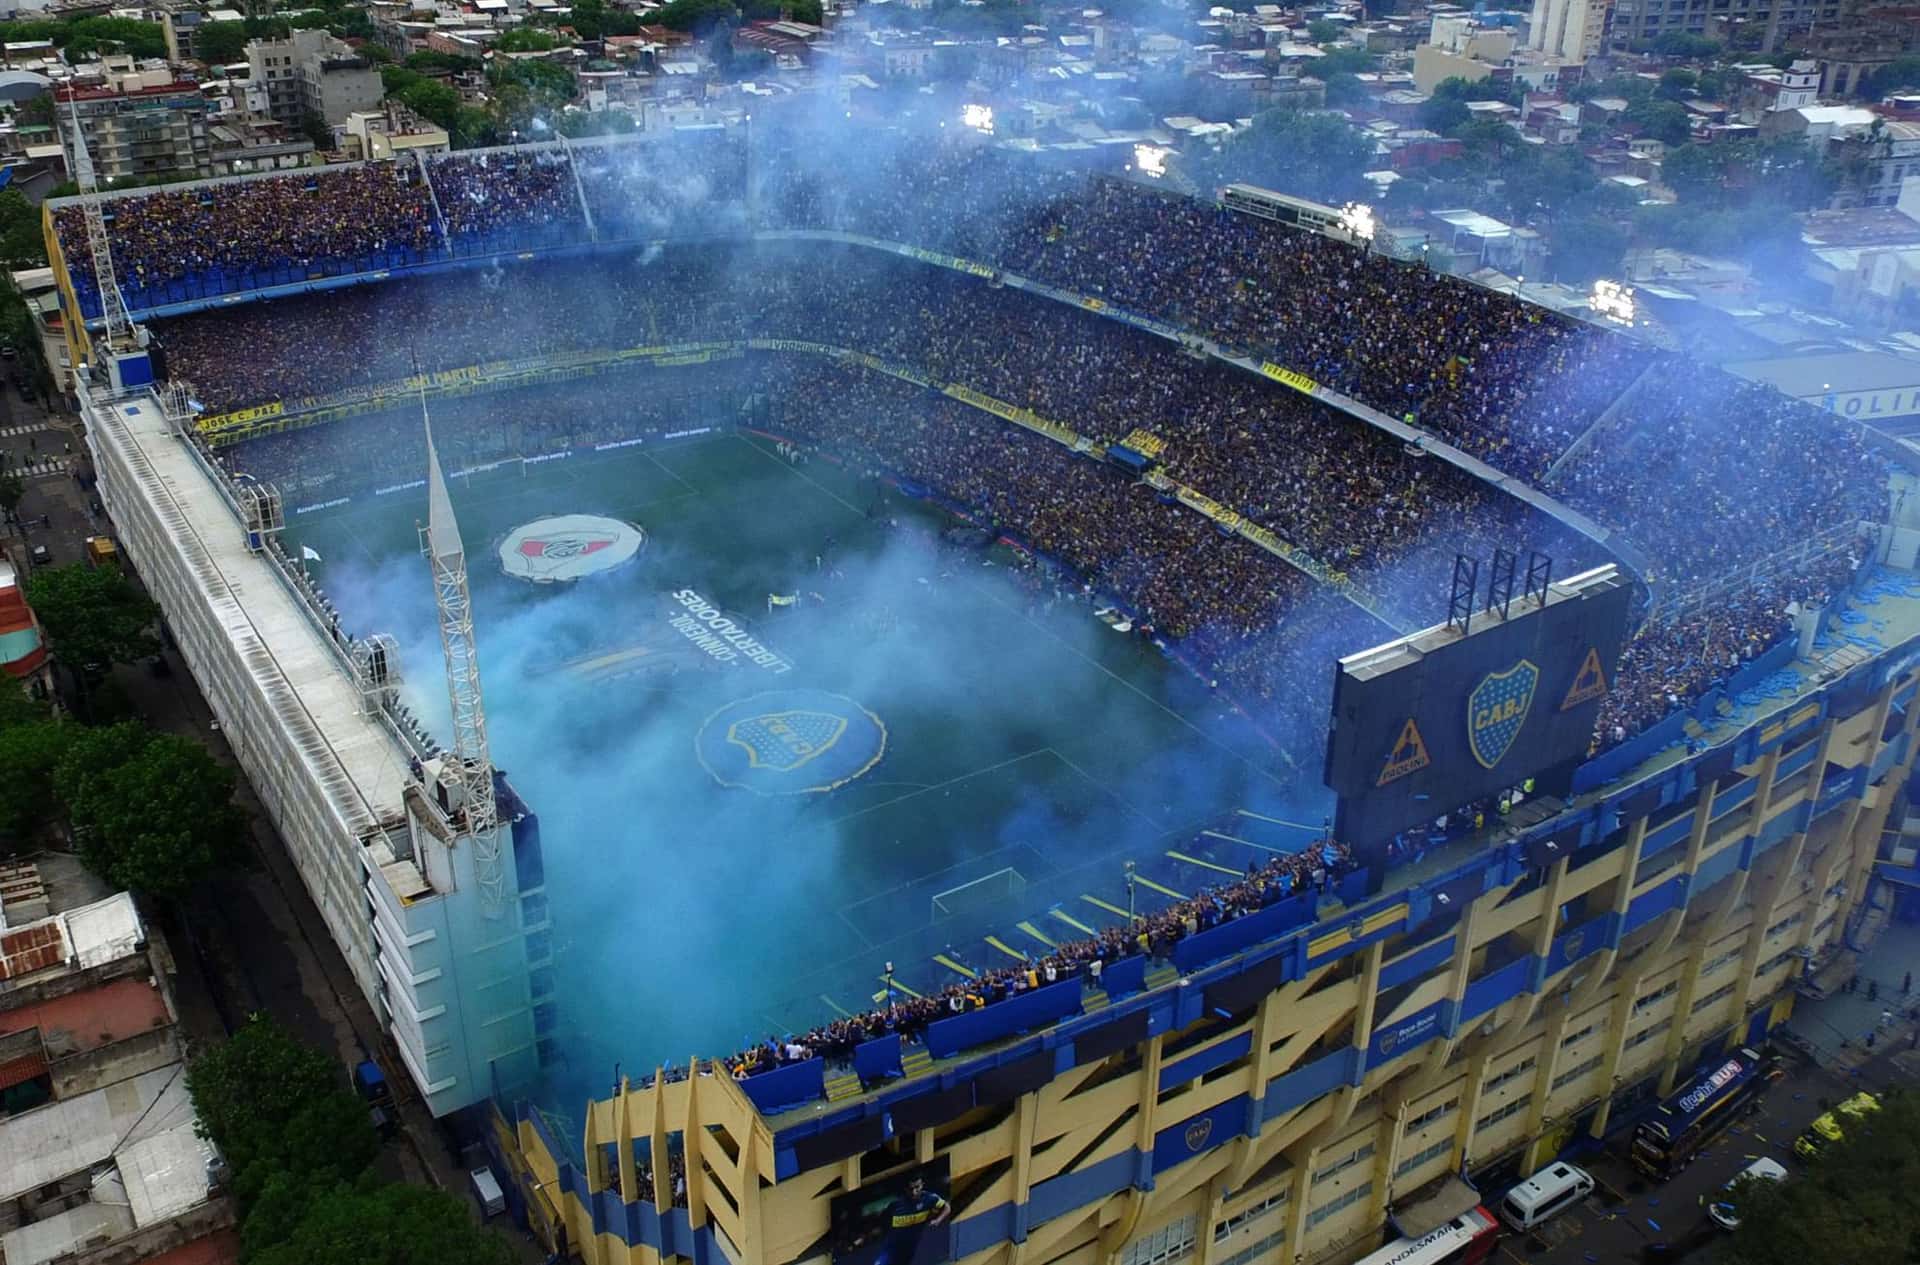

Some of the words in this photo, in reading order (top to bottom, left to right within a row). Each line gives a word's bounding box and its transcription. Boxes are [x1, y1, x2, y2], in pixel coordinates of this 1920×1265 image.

[433, 364, 481, 385] MARTIN
[204, 414, 233, 429] JOSE
[254, 404, 275, 417] PAZ
[669, 613, 737, 661] CONMEBOL
[672, 590, 792, 674] LIBERTADORES
[1475, 693, 1528, 730] CABJ
